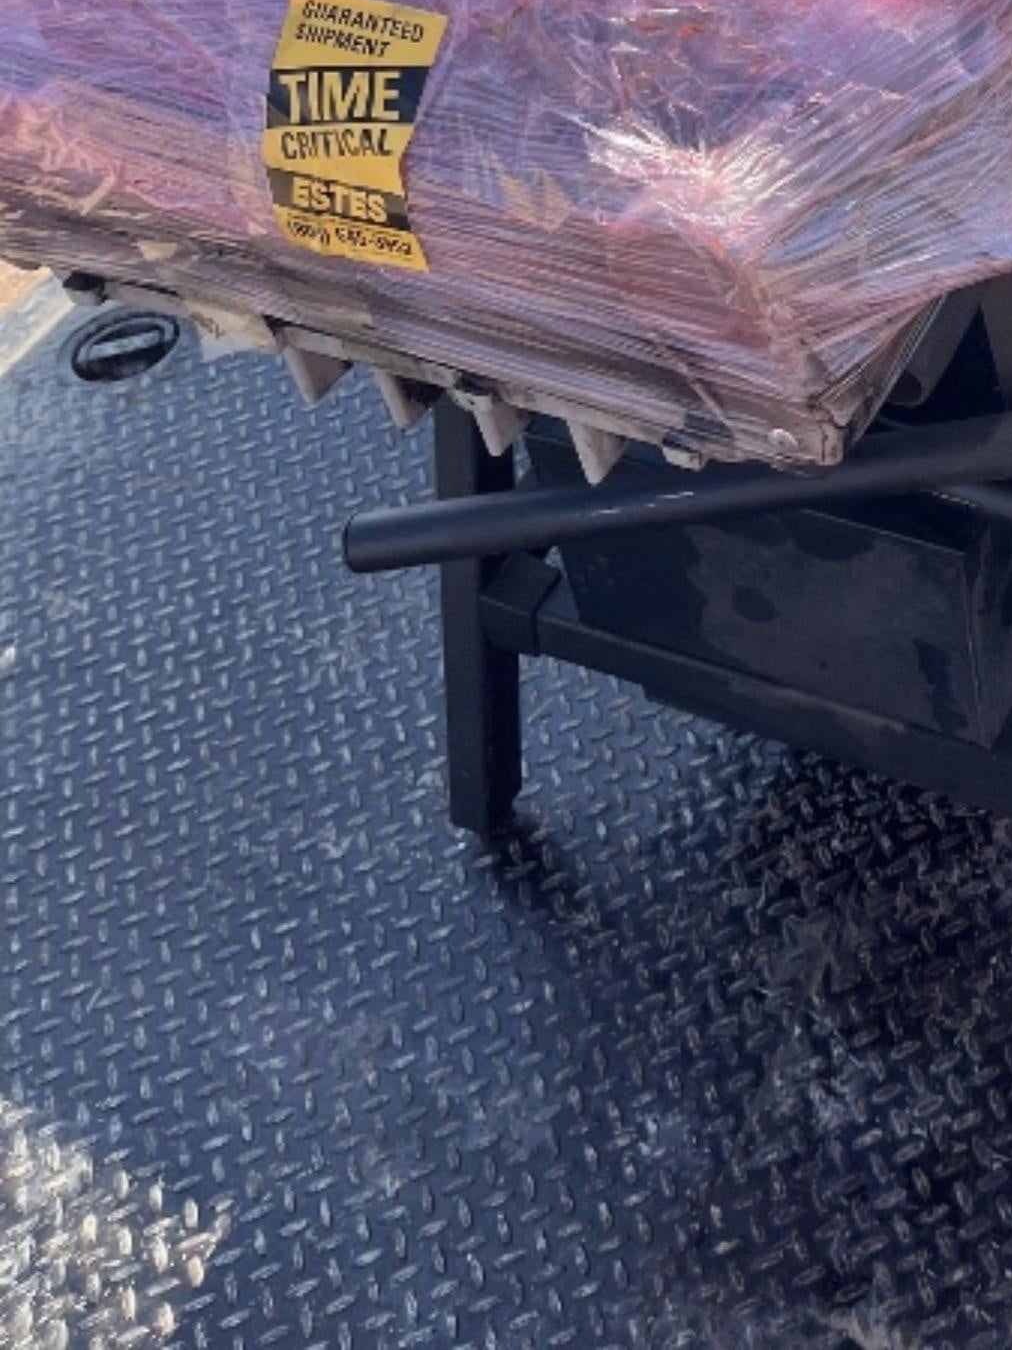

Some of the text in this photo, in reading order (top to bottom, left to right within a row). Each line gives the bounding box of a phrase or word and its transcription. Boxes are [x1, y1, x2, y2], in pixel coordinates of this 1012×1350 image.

[295, 23, 391, 57] SHIPMENT
[301, 0, 424, 42] GUARANTEED
[278, 71, 401, 124] TIME
[281, 128, 392, 159] CRITICAL
[293, 176, 387, 223] ESTES
